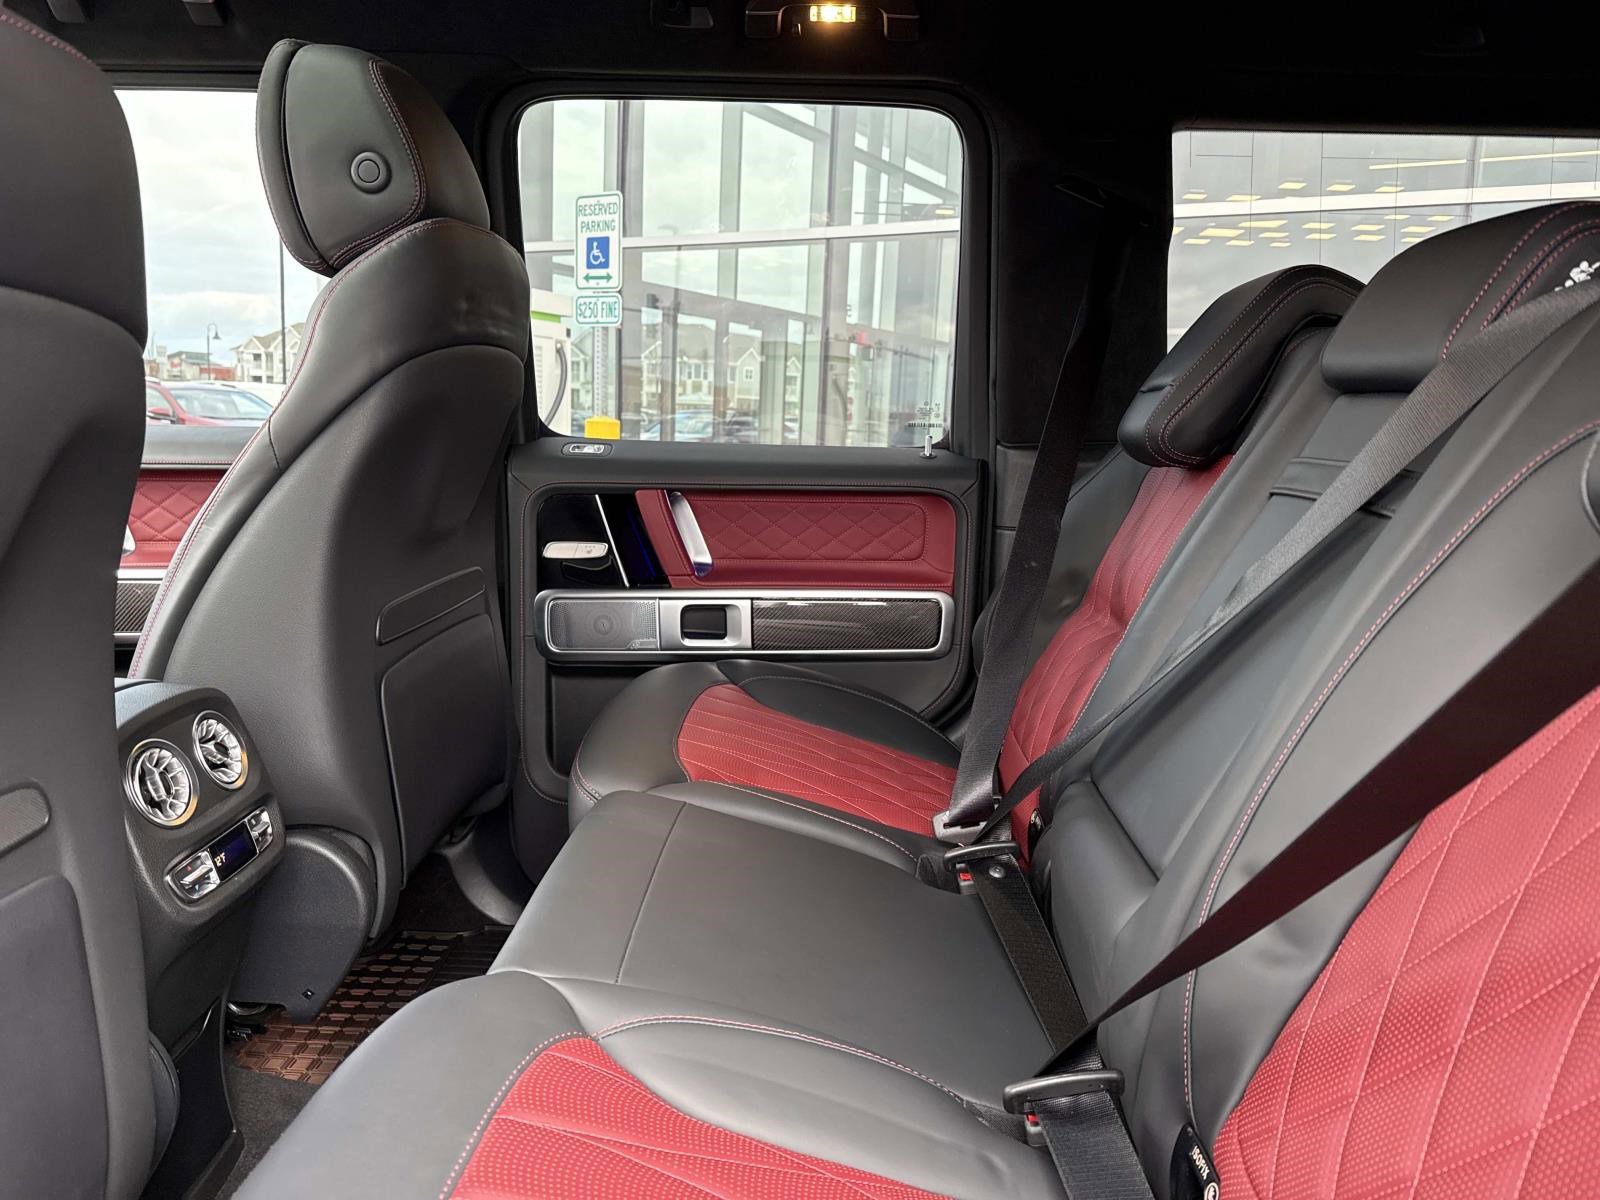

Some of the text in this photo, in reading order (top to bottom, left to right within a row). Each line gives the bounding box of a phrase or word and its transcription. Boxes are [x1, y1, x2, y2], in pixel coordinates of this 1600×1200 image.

[578, 202, 618, 217] RESERVED
[580, 219, 616, 233] PARKING
[578, 301, 618, 319] $250 FINE
[1191, 1145, 1210, 1180] ISOFIX
